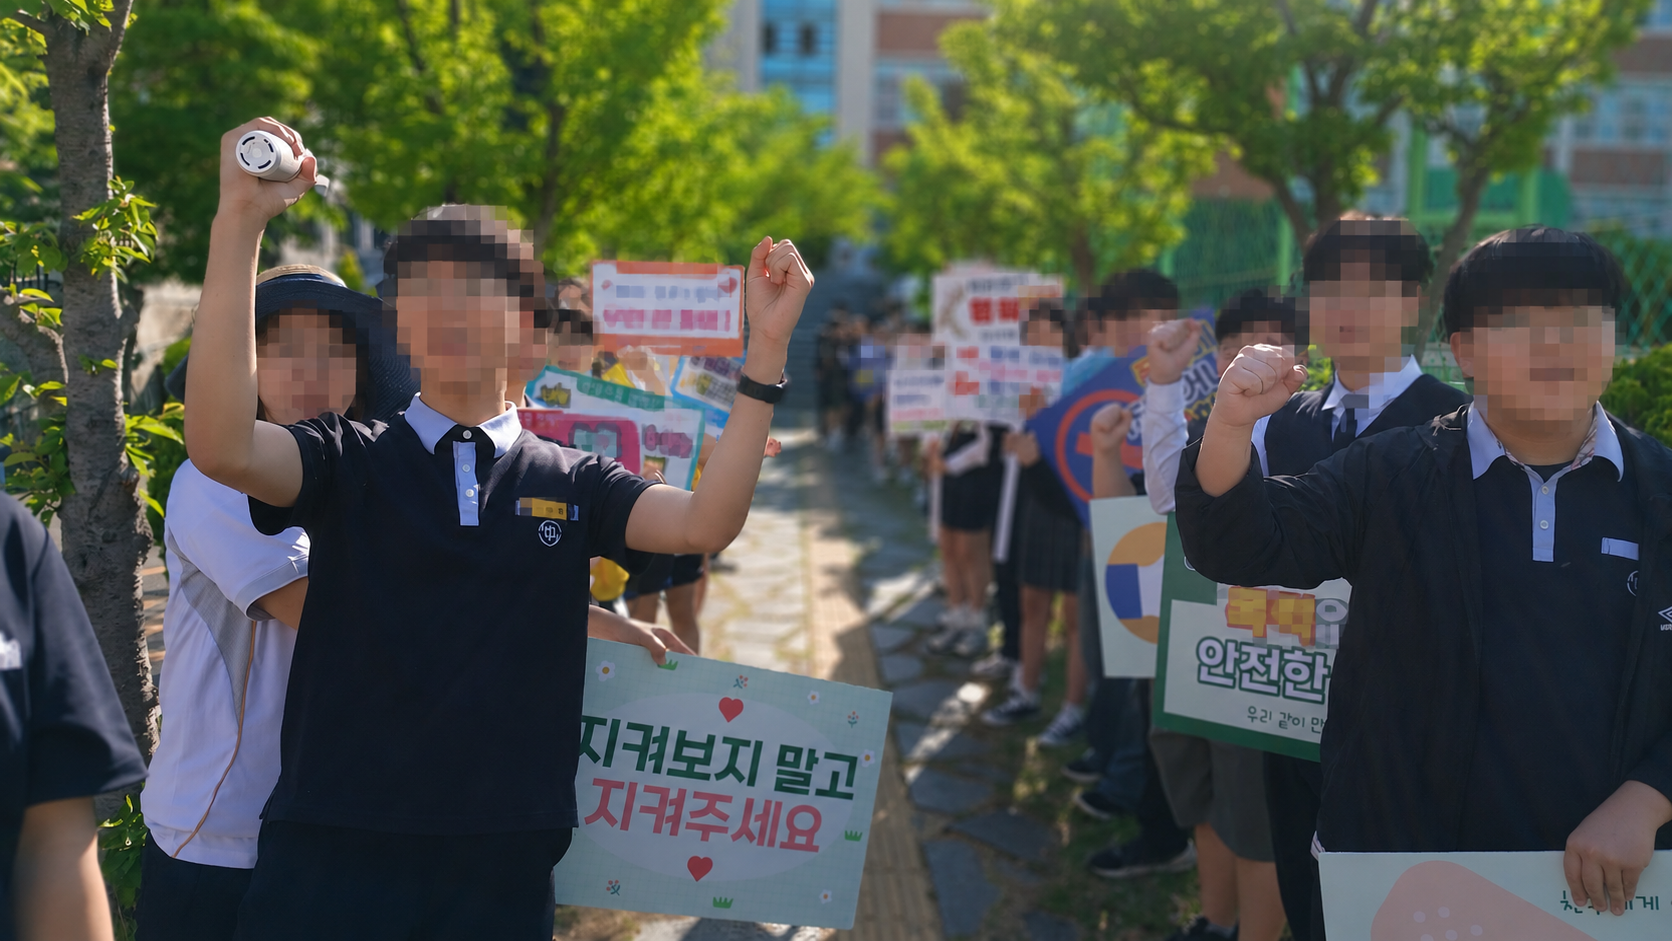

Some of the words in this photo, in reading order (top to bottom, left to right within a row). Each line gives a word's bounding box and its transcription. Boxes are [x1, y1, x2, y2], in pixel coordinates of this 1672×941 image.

[1196, 636, 1331, 705] 안전한
[1247, 705, 1272, 723] 우리
[1278, 711, 1306, 730] 같이
[579, 715, 764, 788] 지켜보지
[774, 743, 859, 801] 말고
[583, 777, 823, 853] 지켜주세요
